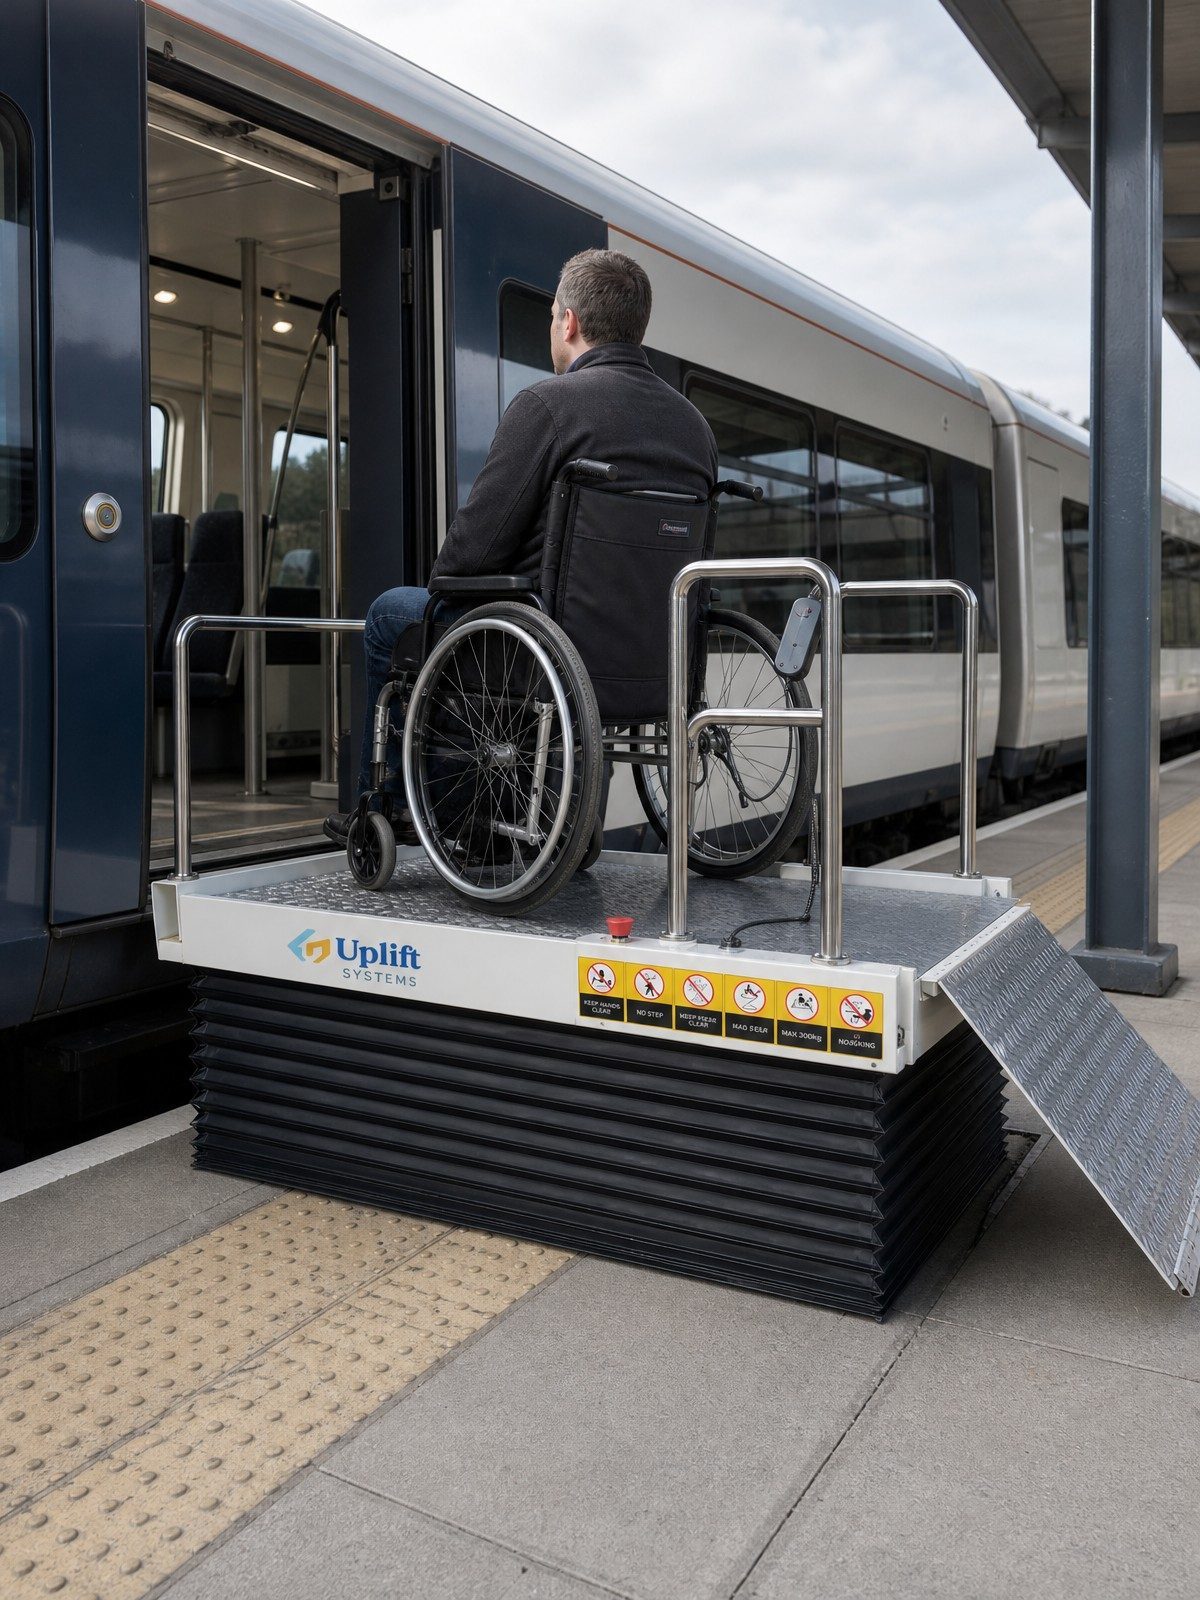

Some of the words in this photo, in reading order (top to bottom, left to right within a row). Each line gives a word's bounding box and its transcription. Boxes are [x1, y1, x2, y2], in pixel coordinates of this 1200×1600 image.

[336, 937, 421, 970] Uplift
[343, 968, 417, 987] SYSTEMS
[636, 1009, 647, 1017] NO
[648, 1010, 664, 1018] STEP
